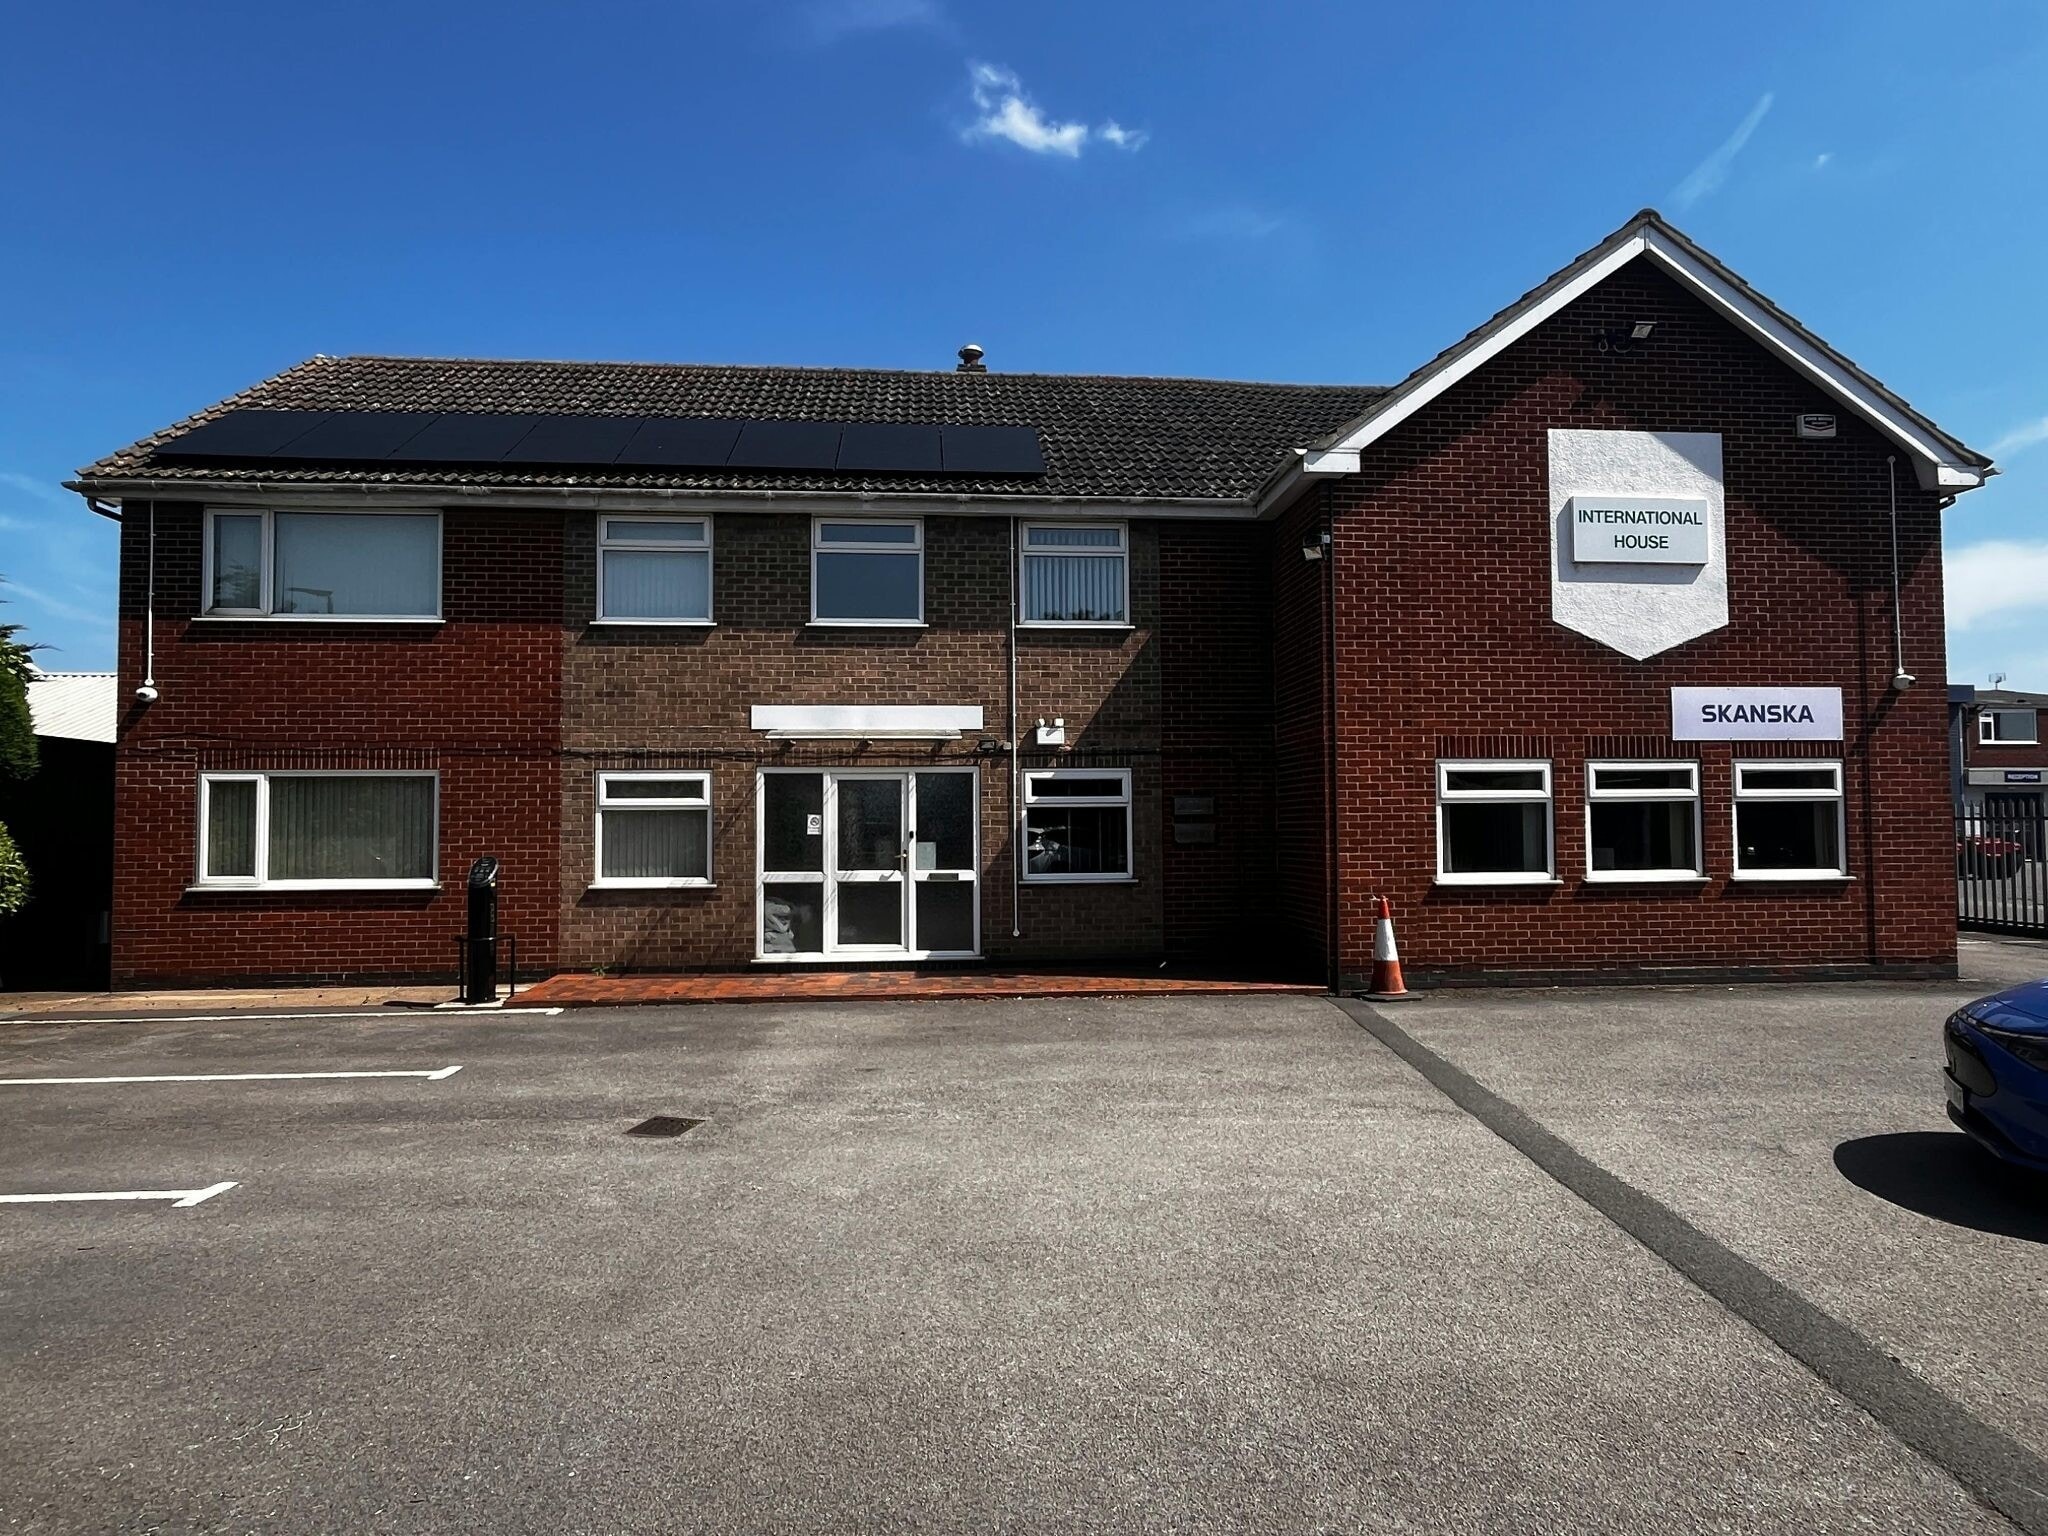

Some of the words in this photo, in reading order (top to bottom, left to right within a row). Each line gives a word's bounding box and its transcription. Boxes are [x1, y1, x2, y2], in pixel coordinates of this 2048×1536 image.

[1578, 510, 1703, 525] INTERNATIONAL
[1614, 535, 1669, 549] HOUSE
[1701, 704, 1815, 723] SKANSKA
